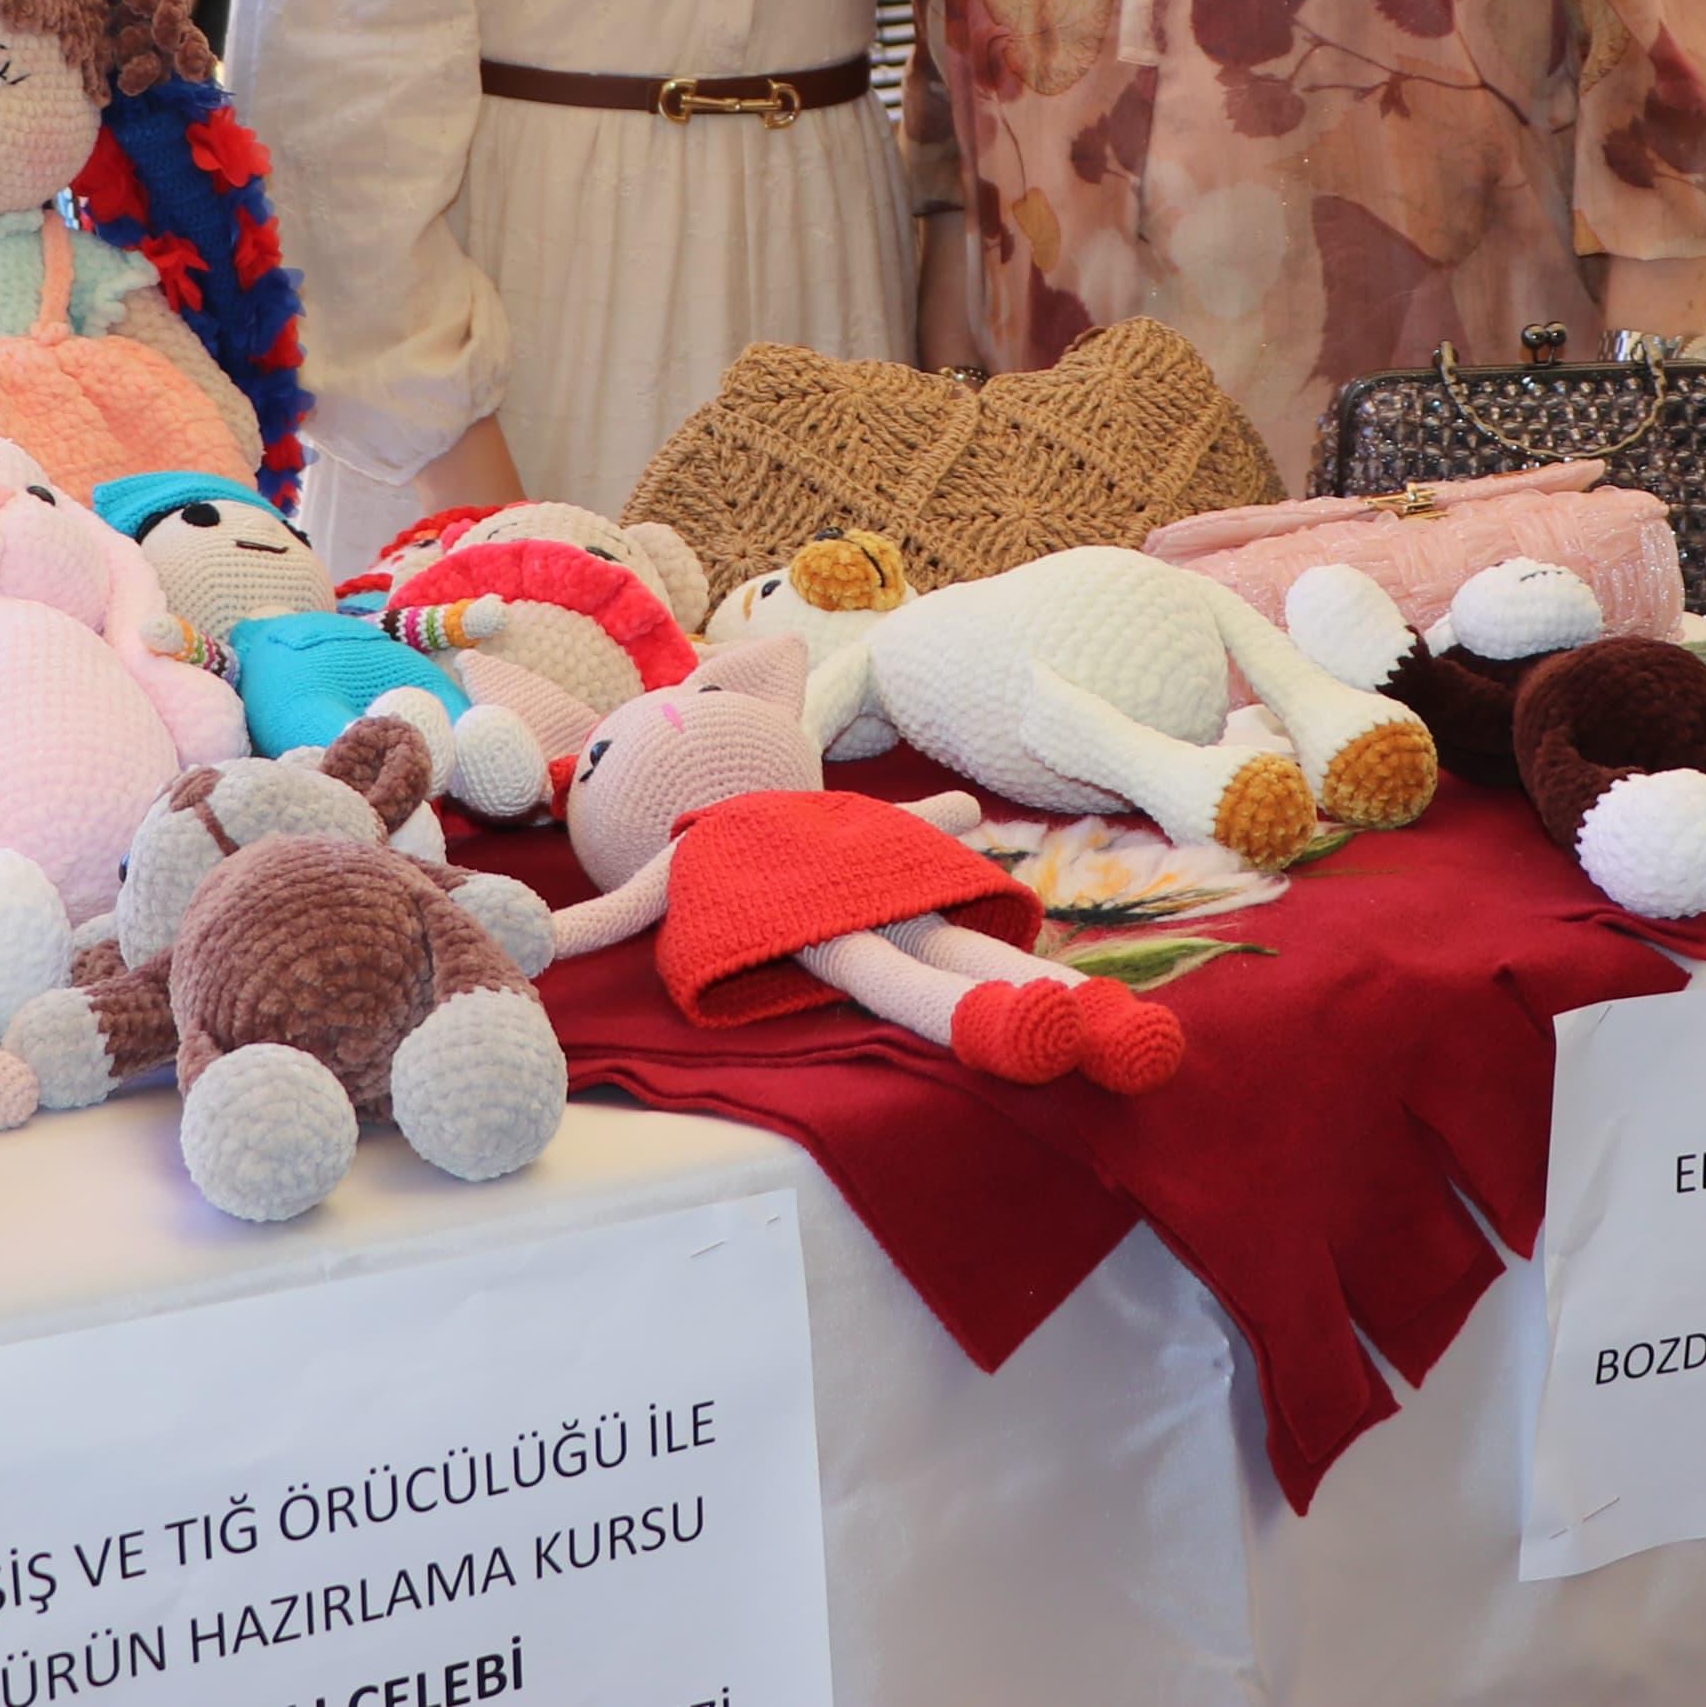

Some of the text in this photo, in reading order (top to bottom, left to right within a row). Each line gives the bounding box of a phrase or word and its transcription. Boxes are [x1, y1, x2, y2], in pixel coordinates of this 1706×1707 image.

[73, 1530, 147, 1588] VE
[164, 1492, 258, 1566] TIĞ
[278, 1411, 628, 1542] ÖRÜCÜLÜĞÜ
[648, 1400, 717, 1458] İLE
[1, 1495, 705, 1707] ÜRÜN HAZIRLAMA KURSU
